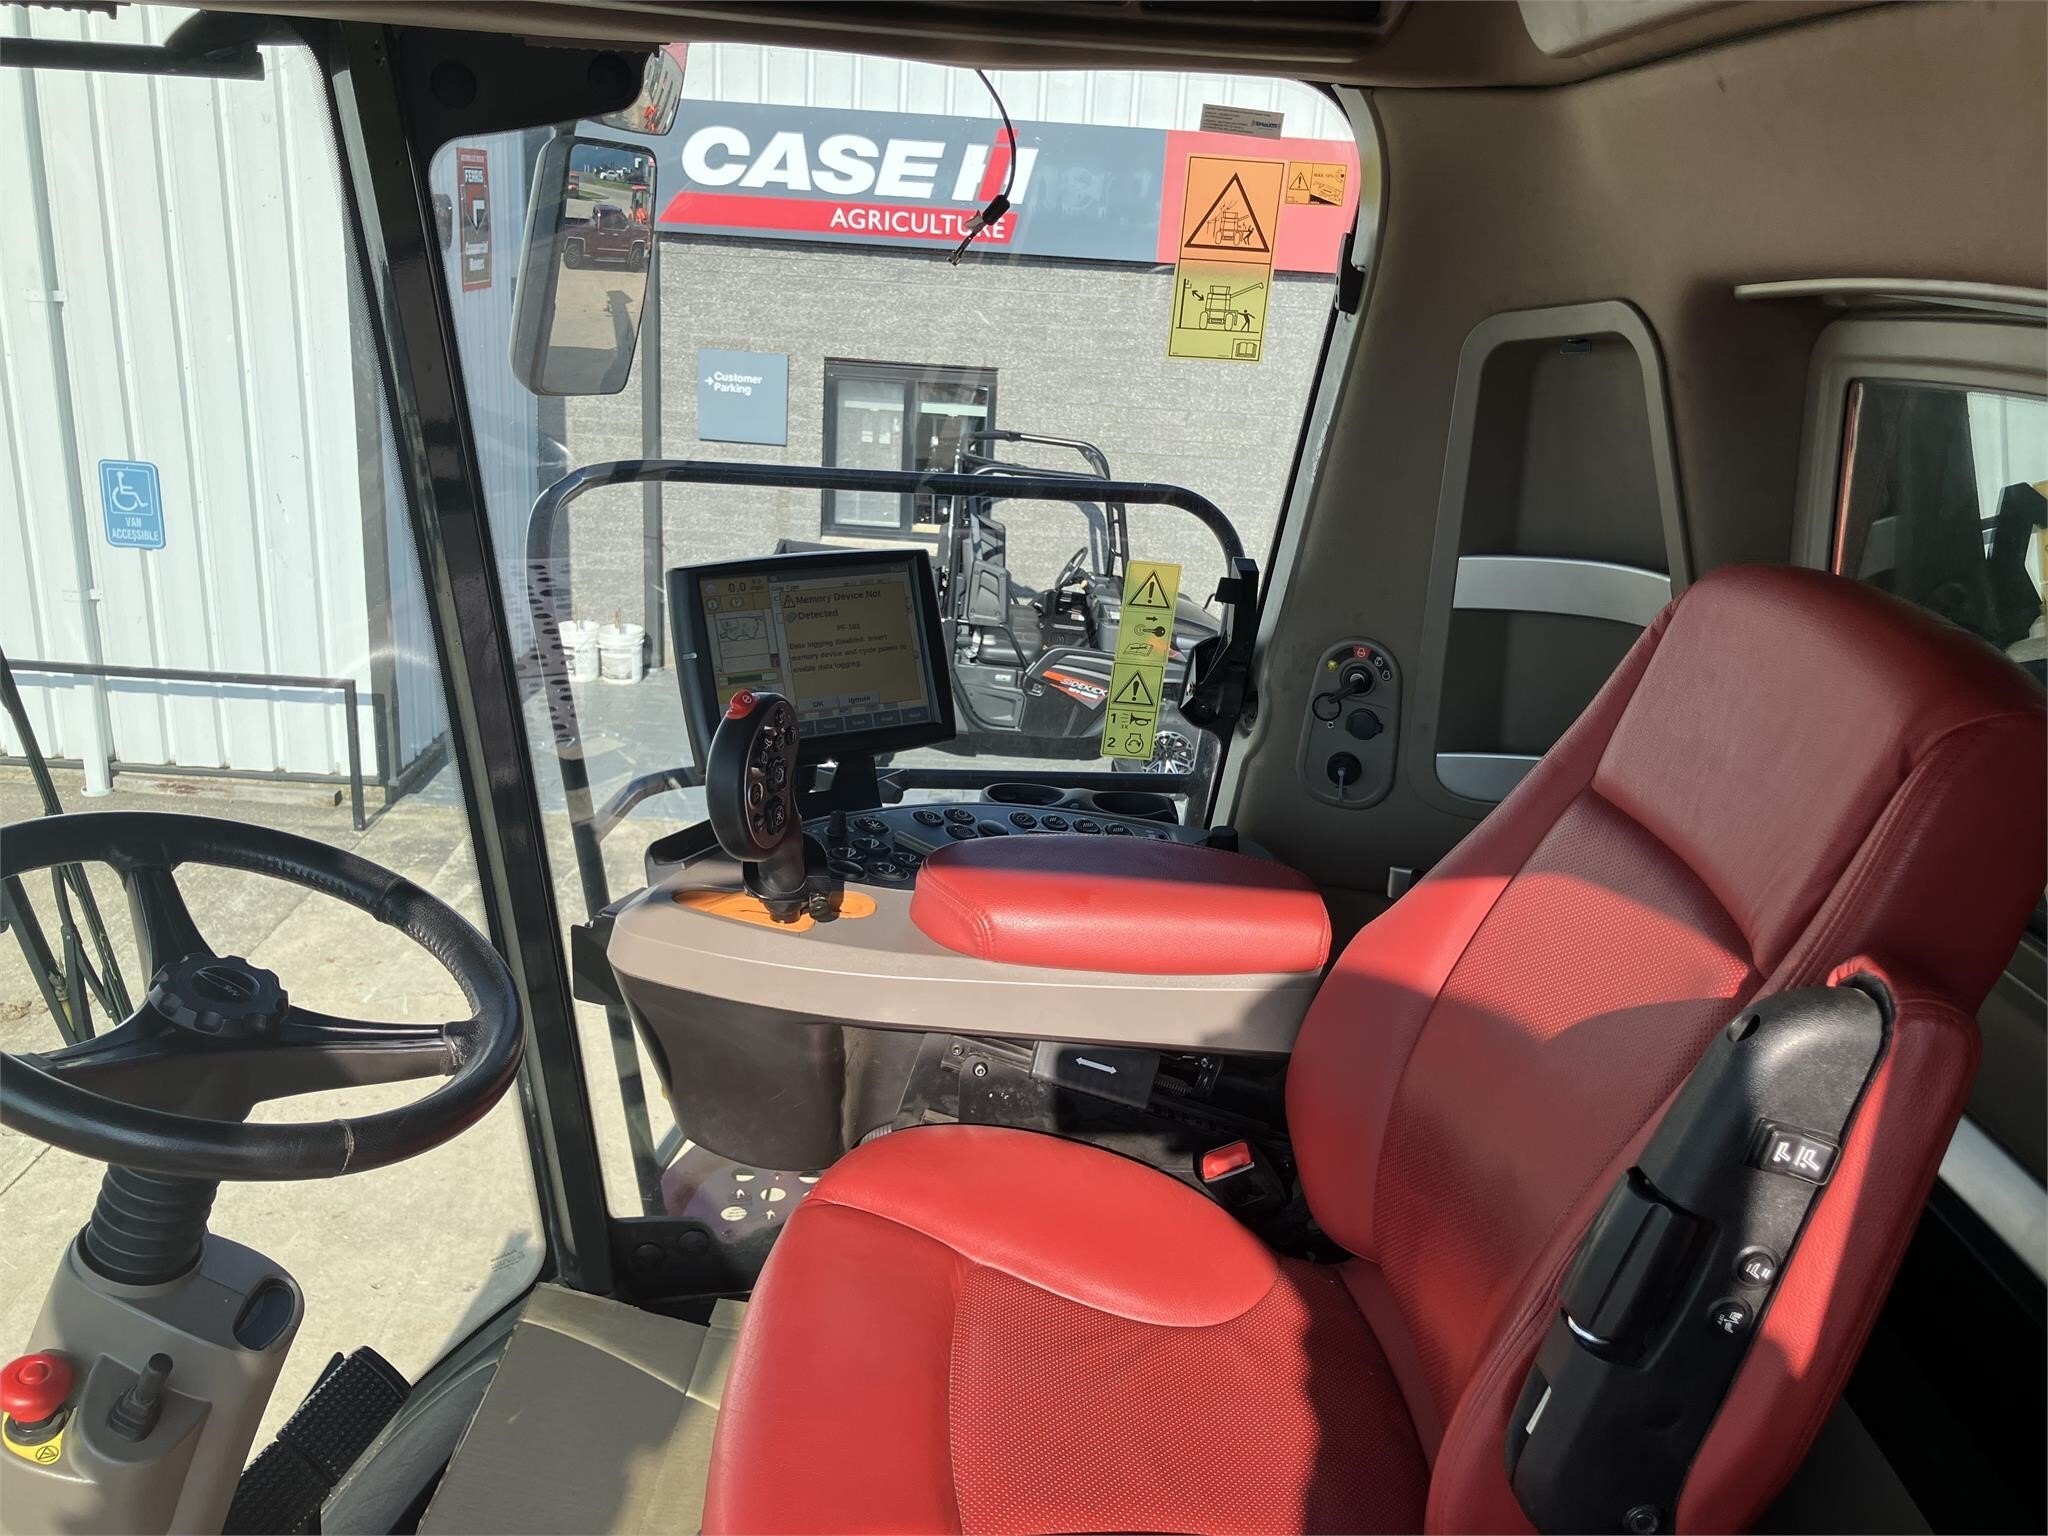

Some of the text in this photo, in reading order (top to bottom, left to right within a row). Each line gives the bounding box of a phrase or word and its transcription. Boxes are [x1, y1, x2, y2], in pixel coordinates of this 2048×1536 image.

[681, 126, 946, 199] CASE
[713, 371, 763, 384] Customer
[713, 382, 752, 396] Parking
[125, 517, 141, 527] VAN
[112, 528, 159, 541] ACCESSIBLE
[796, 589, 882, 604] Memory Device Not
[798, 608, 839, 620] Detected
[1063, 679, 1108, 696] SIDEKICK
[1111, 713, 1116, 723] 1
[1107, 737, 1116, 747] 2
